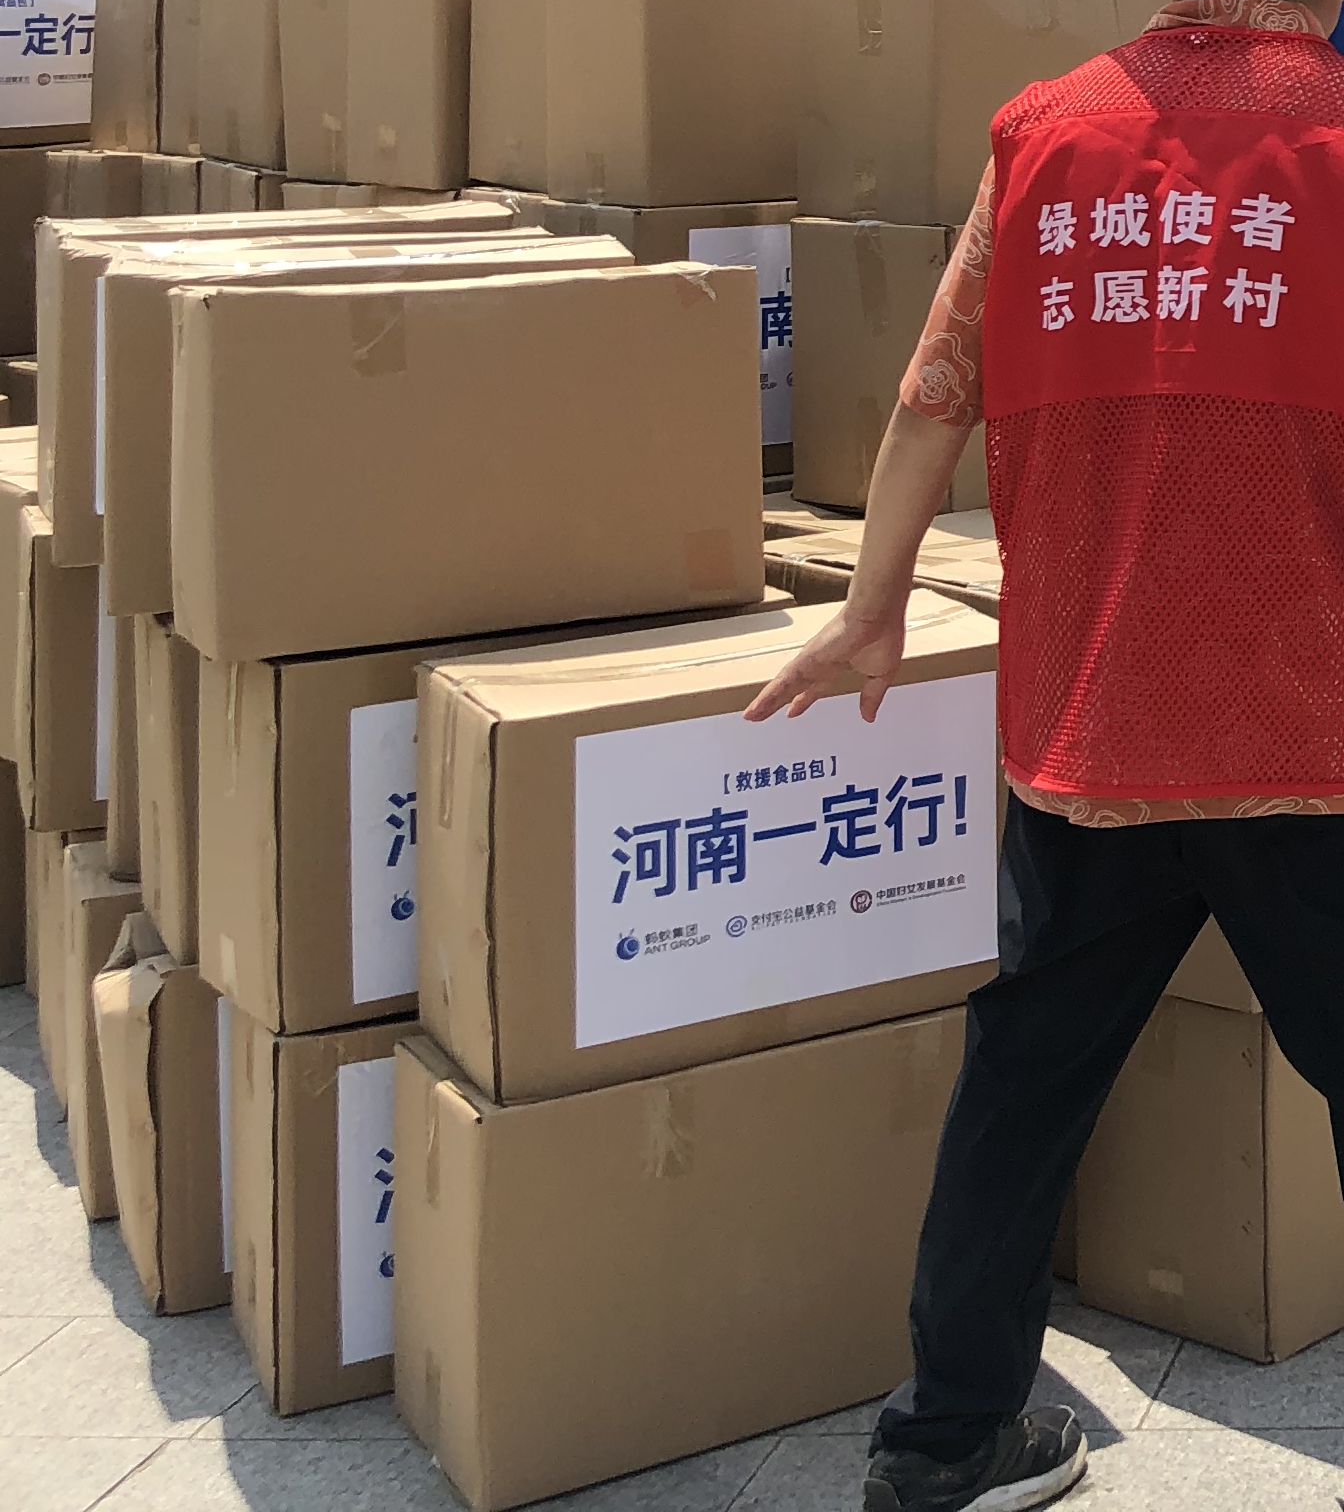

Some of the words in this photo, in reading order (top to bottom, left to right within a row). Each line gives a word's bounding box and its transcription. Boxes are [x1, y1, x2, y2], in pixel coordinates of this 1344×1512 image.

[1037, 190, 1297, 257] 绿城使者
[1039, 264, 1290, 332] 志愿新村
[723, 755, 838, 795] 【救援食品包】
[610, 772, 967, 904] 河南一定行!
[644, 941, 670, 956] ANT
[670, 932, 711, 951] GROUP
